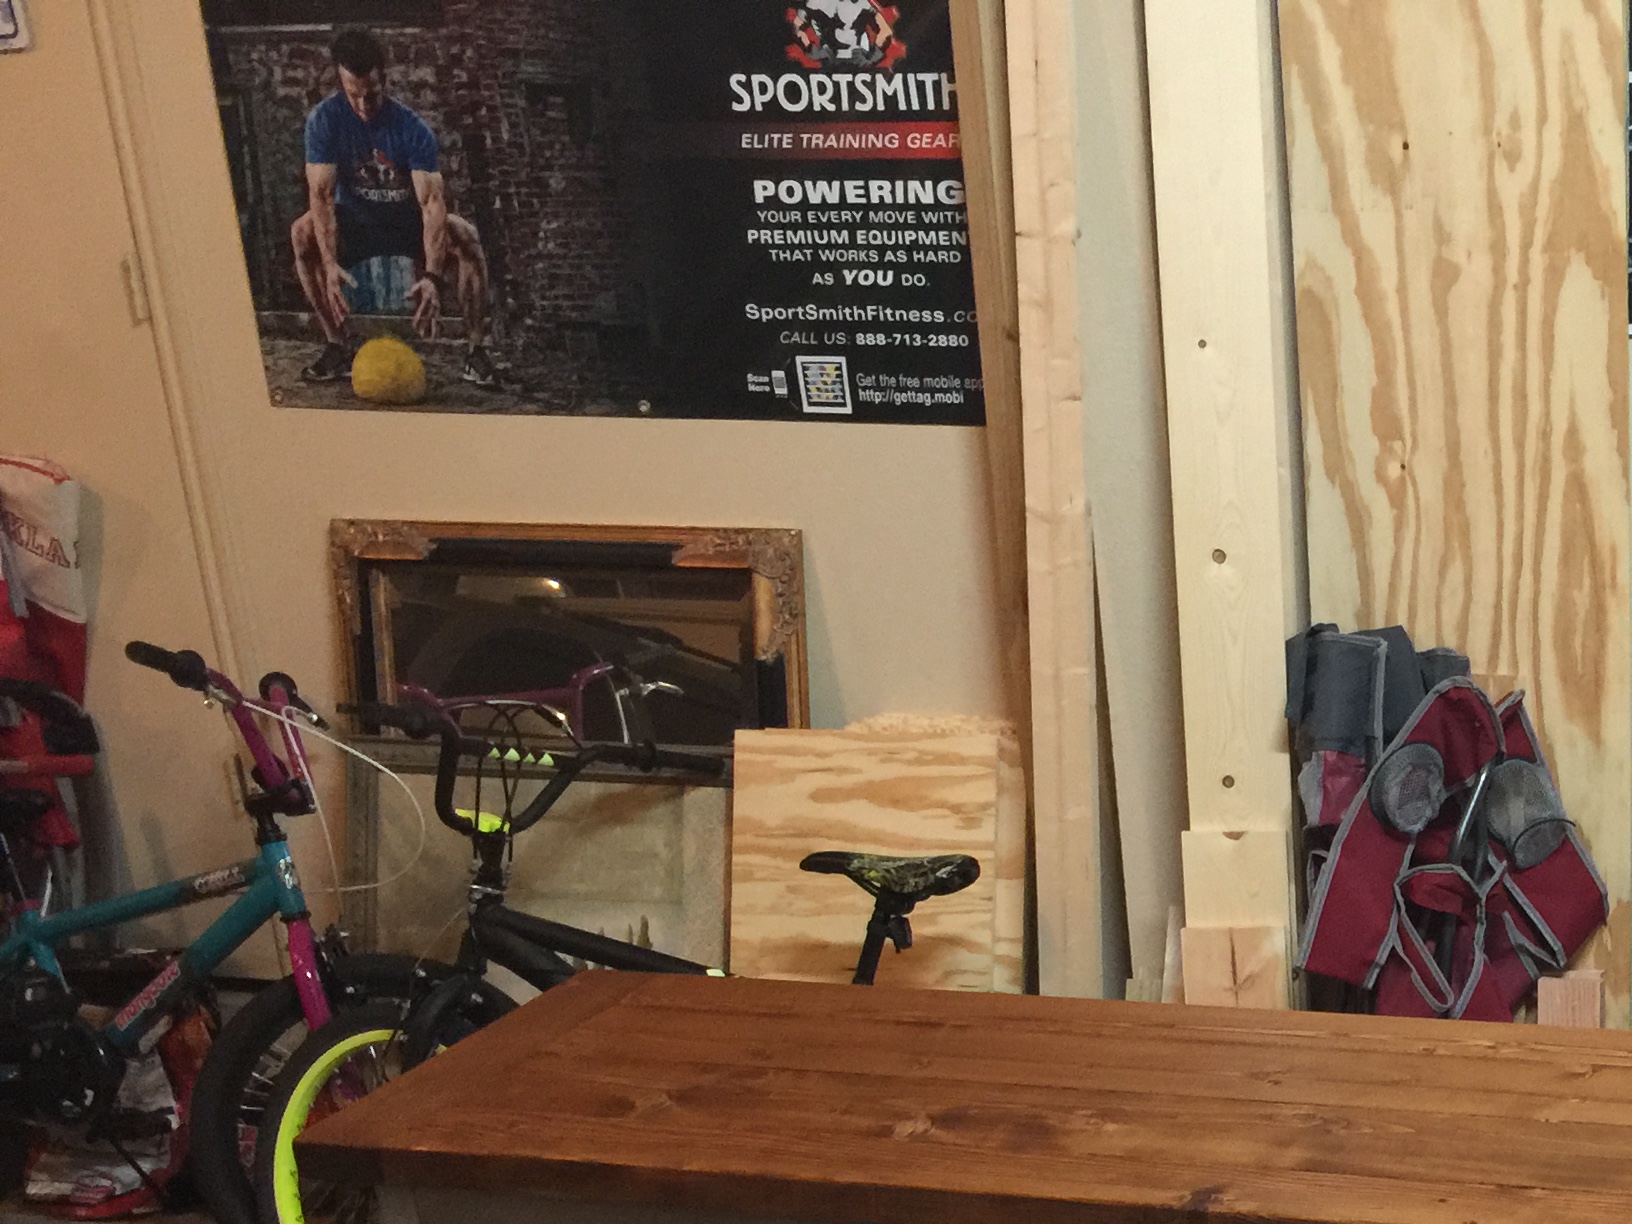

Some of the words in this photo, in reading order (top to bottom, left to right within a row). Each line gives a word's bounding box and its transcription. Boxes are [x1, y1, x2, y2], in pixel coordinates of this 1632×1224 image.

[729, 73, 957, 112] SPORTSMITH
[741, 133, 793, 149] ELITE
[800, 133, 899, 149] TRAINING
[753, 180, 966, 205] POWERING
[757, 210, 802, 224] YOUR
[807, 210, 863, 224] EVERY
[869, 210, 917, 224] MOVE
[921, 210, 968, 224] WITH
[747, 229, 849, 245] PREMIUM
[856, 230, 967, 246] EQUIPMEN
[769, 249, 812, 262] THAT
[818, 249, 879, 263] WORKS
[884, 250, 907, 263] AS
[913, 250, 962, 263] HARD
[812, 272, 834, 285] AS
[843, 269, 894, 286] YOU
[901, 273, 931, 286] DO.
[745, 304, 978, 323] SportSmithFitness.co
[780, 331, 818, 345] CALL
[855, 333, 969, 347] 888-713-2880
[856, 373, 877, 387] Get
[879, 373, 897, 388] the
[899, 373, 920, 389] free
[923, 375, 961, 389] mobile
